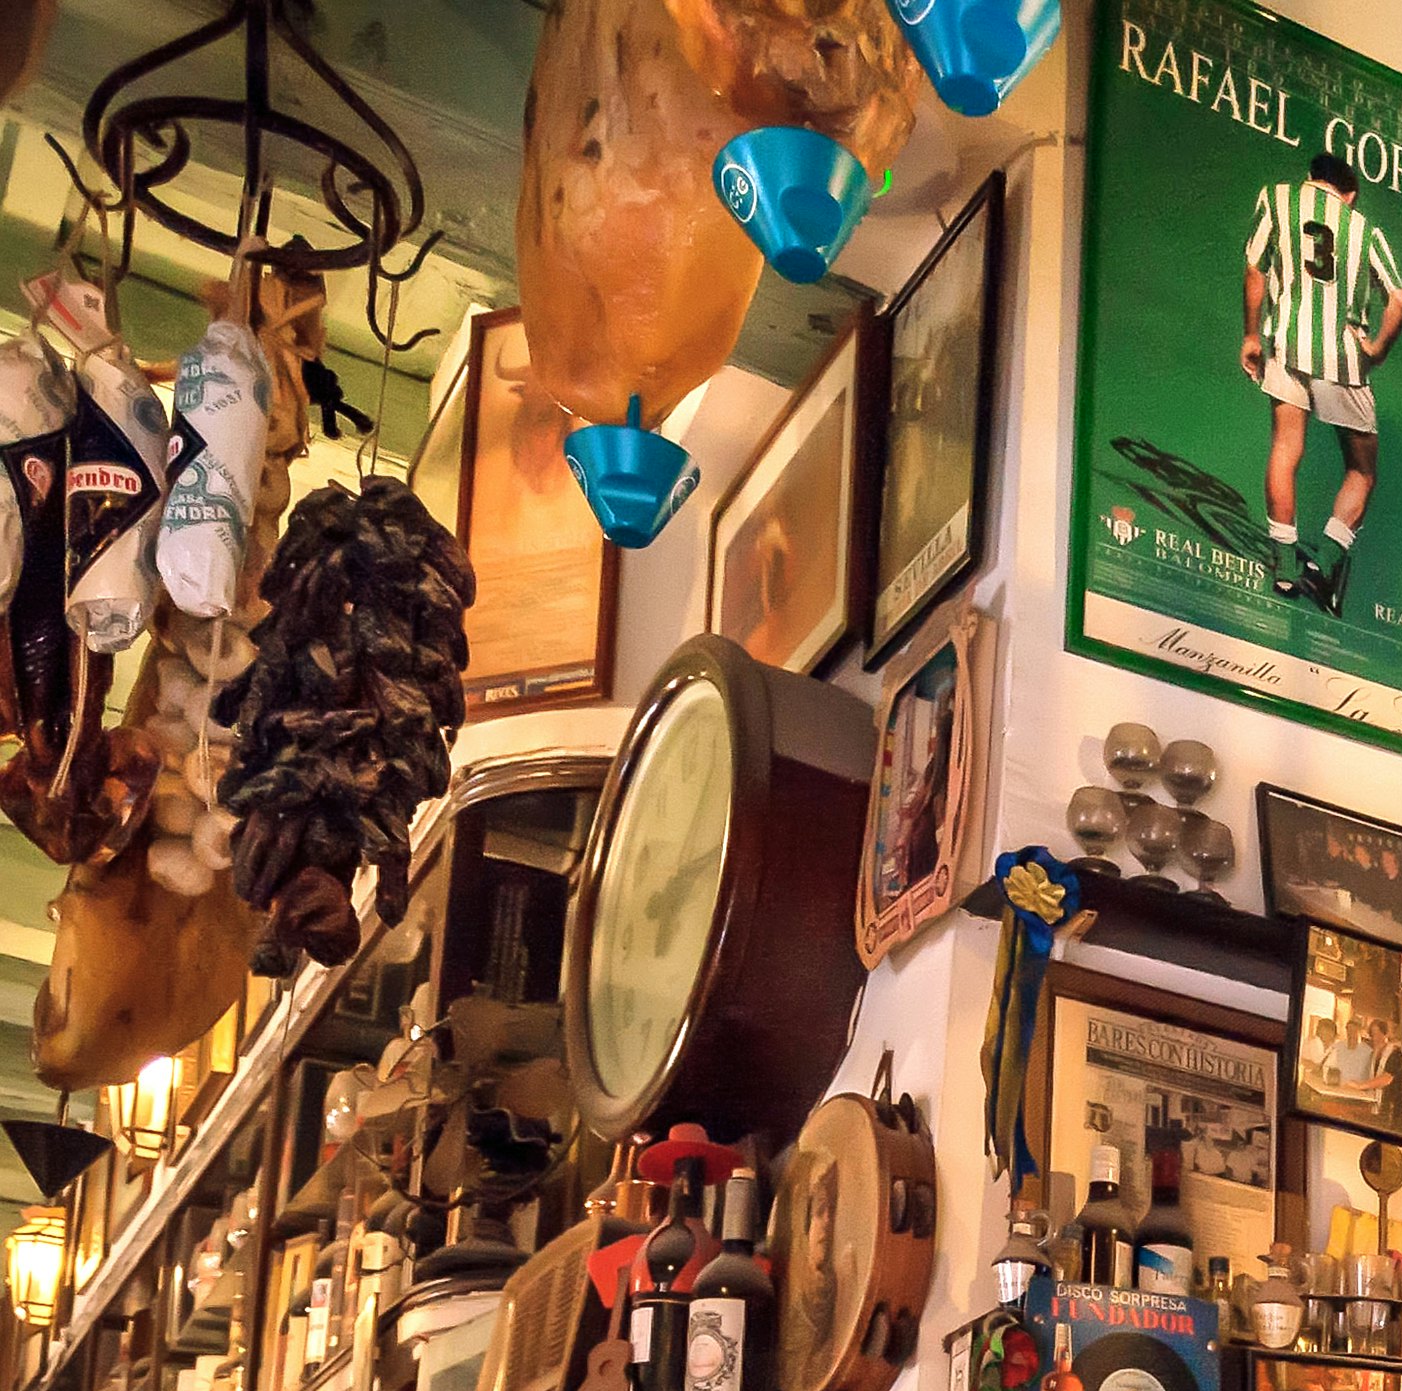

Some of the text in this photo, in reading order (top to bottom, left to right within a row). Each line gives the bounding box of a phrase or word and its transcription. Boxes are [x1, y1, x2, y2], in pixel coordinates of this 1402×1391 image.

[1120, 19, 1300, 147] RAFAEL
[1303, 220, 1337, 281] 3
[164, 503, 231, 521] ENDRA
[1154, 528, 1266, 579] REAL BETIS
[1139, 628, 1284, 687] Manzanilla
[1088, 1020, 1147, 1056] BARES
[1186, 1048, 1267, 1090] HISTORIA
[1056, 1283, 1187, 1313] DISCO SORPRESA
